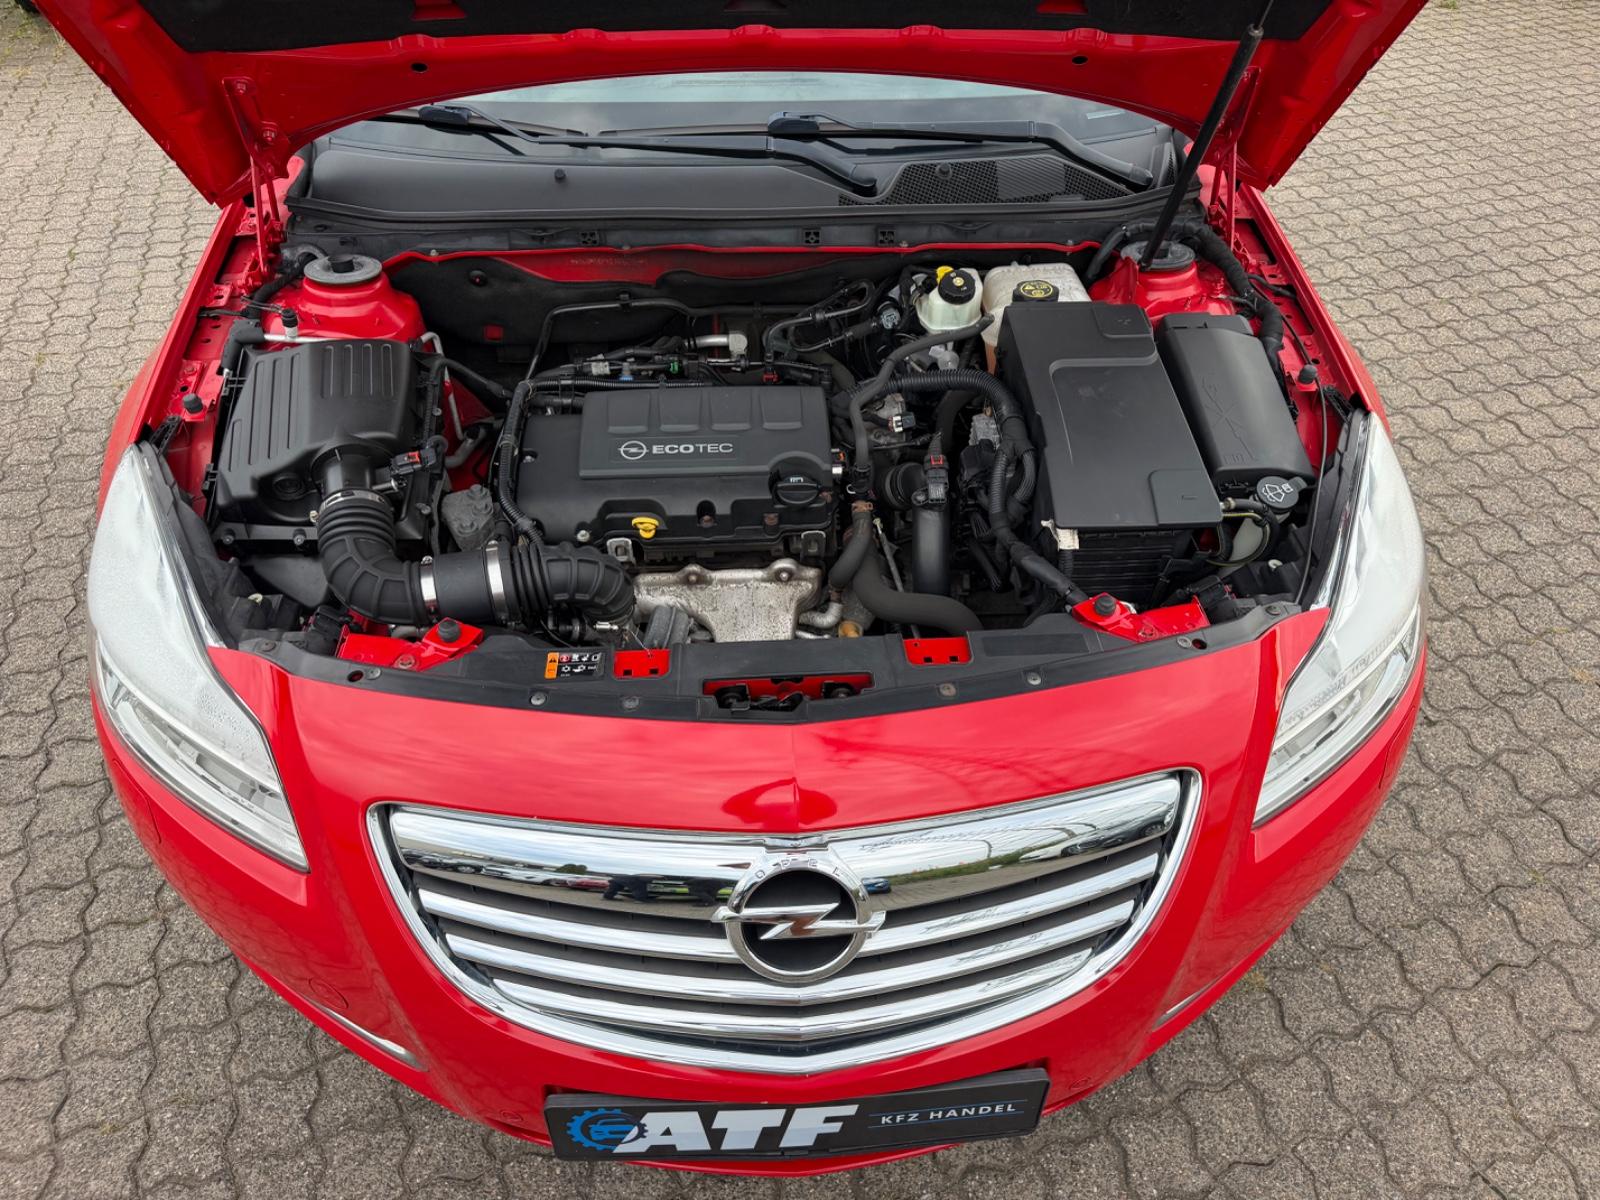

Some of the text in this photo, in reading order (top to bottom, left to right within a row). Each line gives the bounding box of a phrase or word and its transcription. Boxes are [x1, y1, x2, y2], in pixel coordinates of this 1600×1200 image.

[652, 442, 734, 455] ECOTEC
[755, 857, 843, 879] OPEL
[881, 1103, 1017, 1125] KFZ HANDEL
[612, 1104, 859, 1154] ATF
